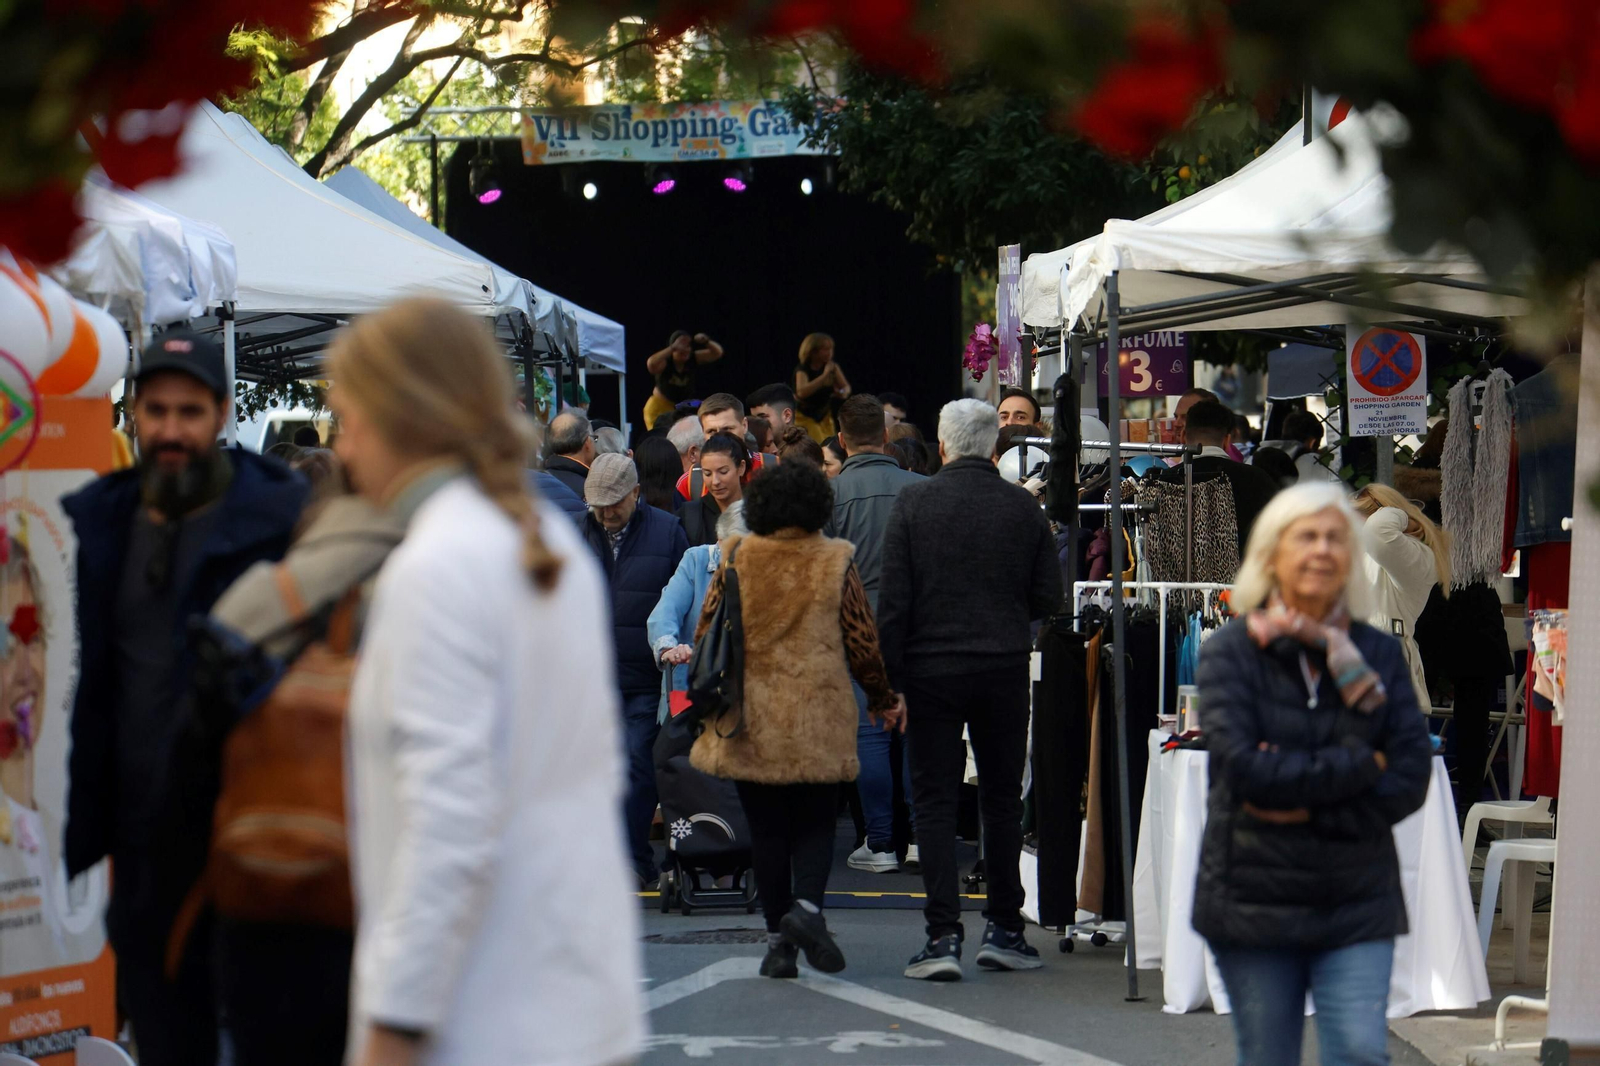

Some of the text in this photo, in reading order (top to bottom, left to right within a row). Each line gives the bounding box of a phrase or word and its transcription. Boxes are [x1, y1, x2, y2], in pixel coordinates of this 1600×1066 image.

[531, 114, 581, 141] VII
[591, 110, 738, 148] Shopping
[1100, 331, 1185, 349] RFUME
[1129, 350, 1163, 392] 3 €
